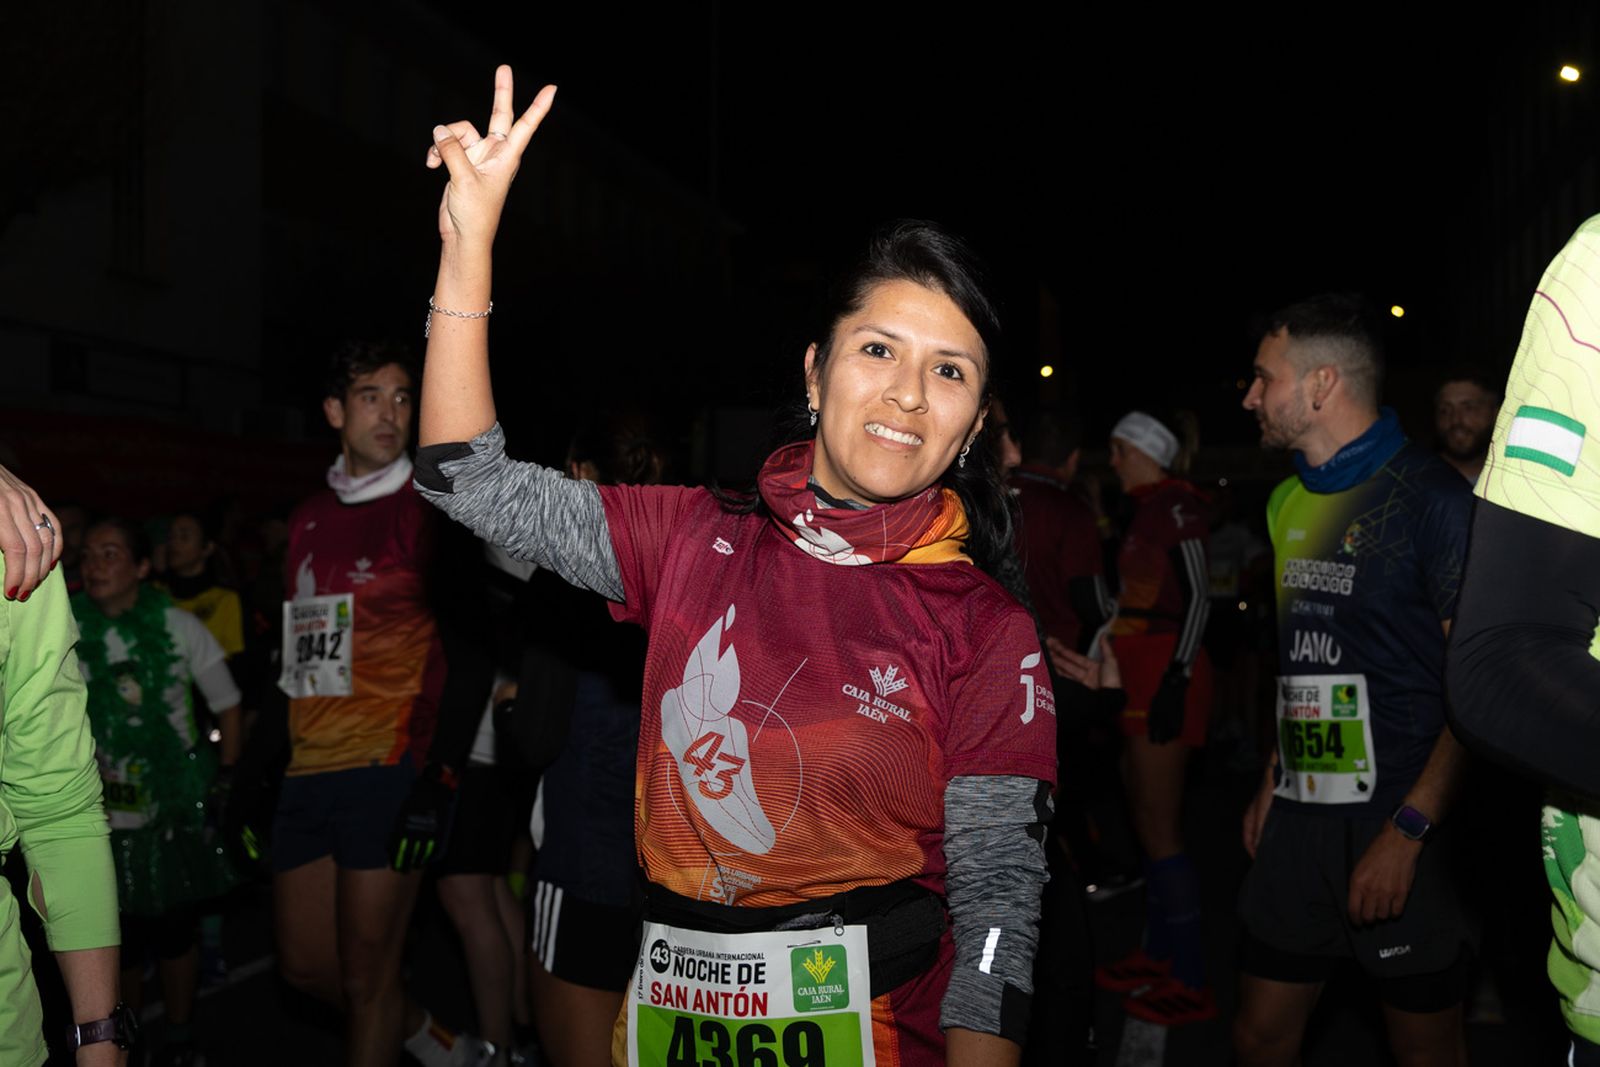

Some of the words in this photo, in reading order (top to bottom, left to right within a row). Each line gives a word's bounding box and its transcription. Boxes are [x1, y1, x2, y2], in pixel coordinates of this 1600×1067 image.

[297, 632, 342, 662] 42
[842, 684, 870, 703] CAJA
[872, 696, 912, 722] RURAL
[856, 703, 889, 724] JAÉN
[1287, 722, 1345, 758] 654
[683, 731, 746, 801] 43
[650, 946, 669, 965] 43
[673, 955, 731, 985] NOCHE
[737, 962, 766, 985] DE
[695, 949, 715, 959] URBANA
[716, 951, 765, 961] INTERNACIONAL
[650, 981, 689, 1010] SAN
[692, 986, 769, 1017] ANTÓN
[797, 986, 817, 996] CAJA
[818, 984, 845, 994] RURAL
[666, 1015, 828, 1067] 4369
